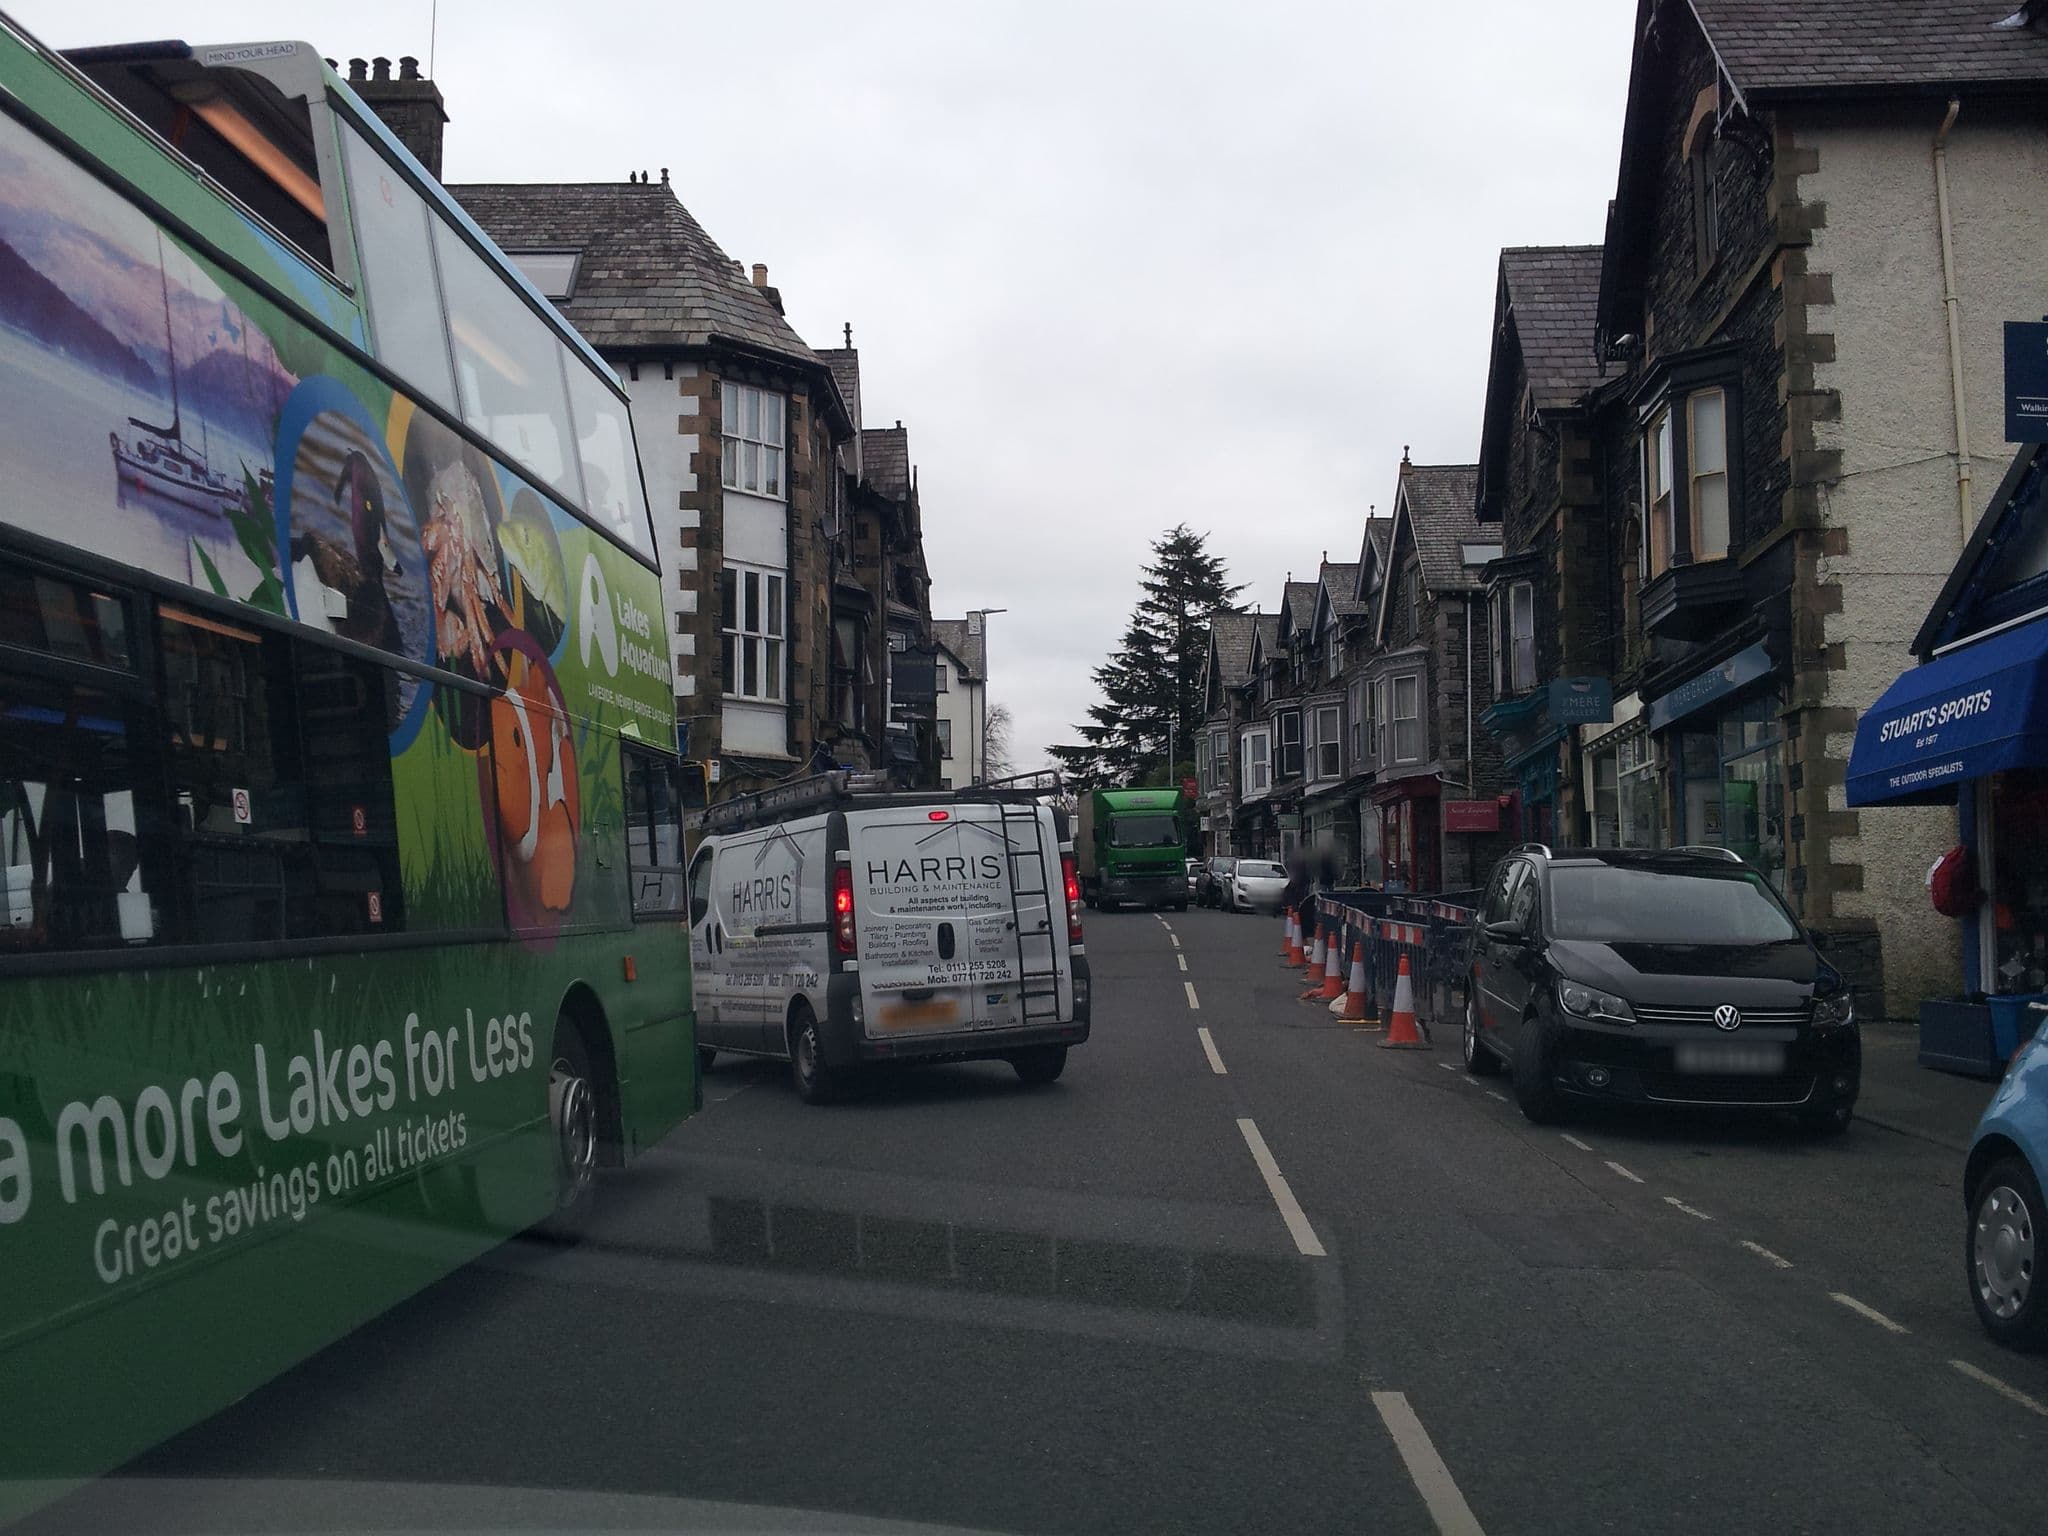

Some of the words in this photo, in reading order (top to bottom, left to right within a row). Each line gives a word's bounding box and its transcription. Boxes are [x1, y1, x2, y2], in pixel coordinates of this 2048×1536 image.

[208, 51, 236, 62] MIND
[237, 47, 264, 59] YOUR
[265, 43, 294, 56] HEAD
[615, 591, 650, 640] Lakes
[620, 632, 672, 687] Aquarium
[1568, 695, 1600, 707] MERE
[1880, 706, 1938, 742] STUART'S
[1937, 689, 1992, 725] SPORTS
[1889, 777, 1901, 788] THE
[1901, 769, 1928, 786] OUTDOOR
[1927, 761, 1964, 779] SPECIALISTS
[867, 855, 1001, 885] HARRIS
[732, 874, 792, 914] HARRIS
[869, 885, 919, 896] BUILDING
[922, 884, 930, 893] &
[933, 881, 1002, 892] MAINTENANCE
[908, 897, 919, 905] All
[920, 896, 950, 905] aspects
[950, 895, 959, 903] of
[960, 894, 989, 903] building
[897, 904, 946, 913] maintenance
[863, 925, 889, 933] Joinery
[894, 923, 932, 931] Decorating
[894, 931, 927, 940] Plumbing
[868, 940, 897, 949] Building
[902, 938, 929, 948] Roofing
[864, 952, 899, 960] Bathroom
[928, 964, 945, 974] Tel:
[946, 962, 967, 972] 0113
[968, 960, 985, 971] 255
[986, 959, 1007, 970] 5208
[927, 974, 950, 985] Mob:
[952, 972, 977, 983] 07711
[979, 971, 995, 982] 720
[997, 970, 1012, 981] 242
[57, 1071, 243, 1204] more
[255, 1028, 397, 1141] Lakes
[404, 1012, 459, 1101] for
[466, 1007, 534, 1083] Less
[94, 1196, 200, 1284] Great
[206, 1161, 321, 1243] savings
[326, 1149, 359, 1196] on
[364, 1126, 394, 1182] all
[399, 1109, 467, 1170] tickets
